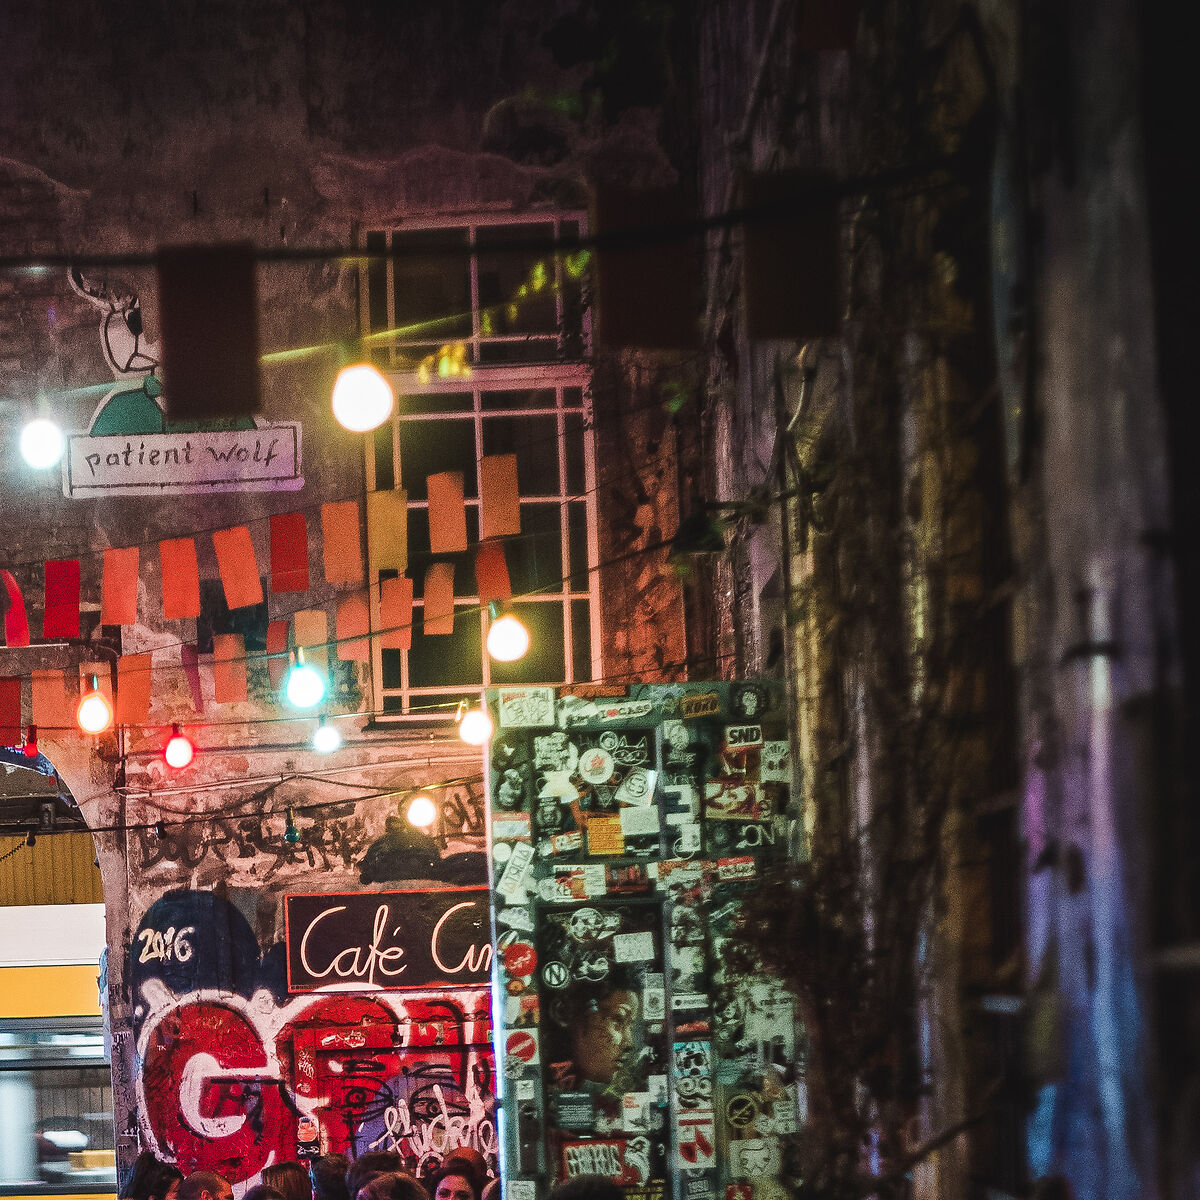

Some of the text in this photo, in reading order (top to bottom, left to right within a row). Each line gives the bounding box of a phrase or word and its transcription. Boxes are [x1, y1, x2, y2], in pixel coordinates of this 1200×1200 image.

[84, 438, 279, 476] patient wolf
[729, 727, 761, 744] SND
[138, 926, 195, 963] 2016
[300, 903, 408, 985] Café
